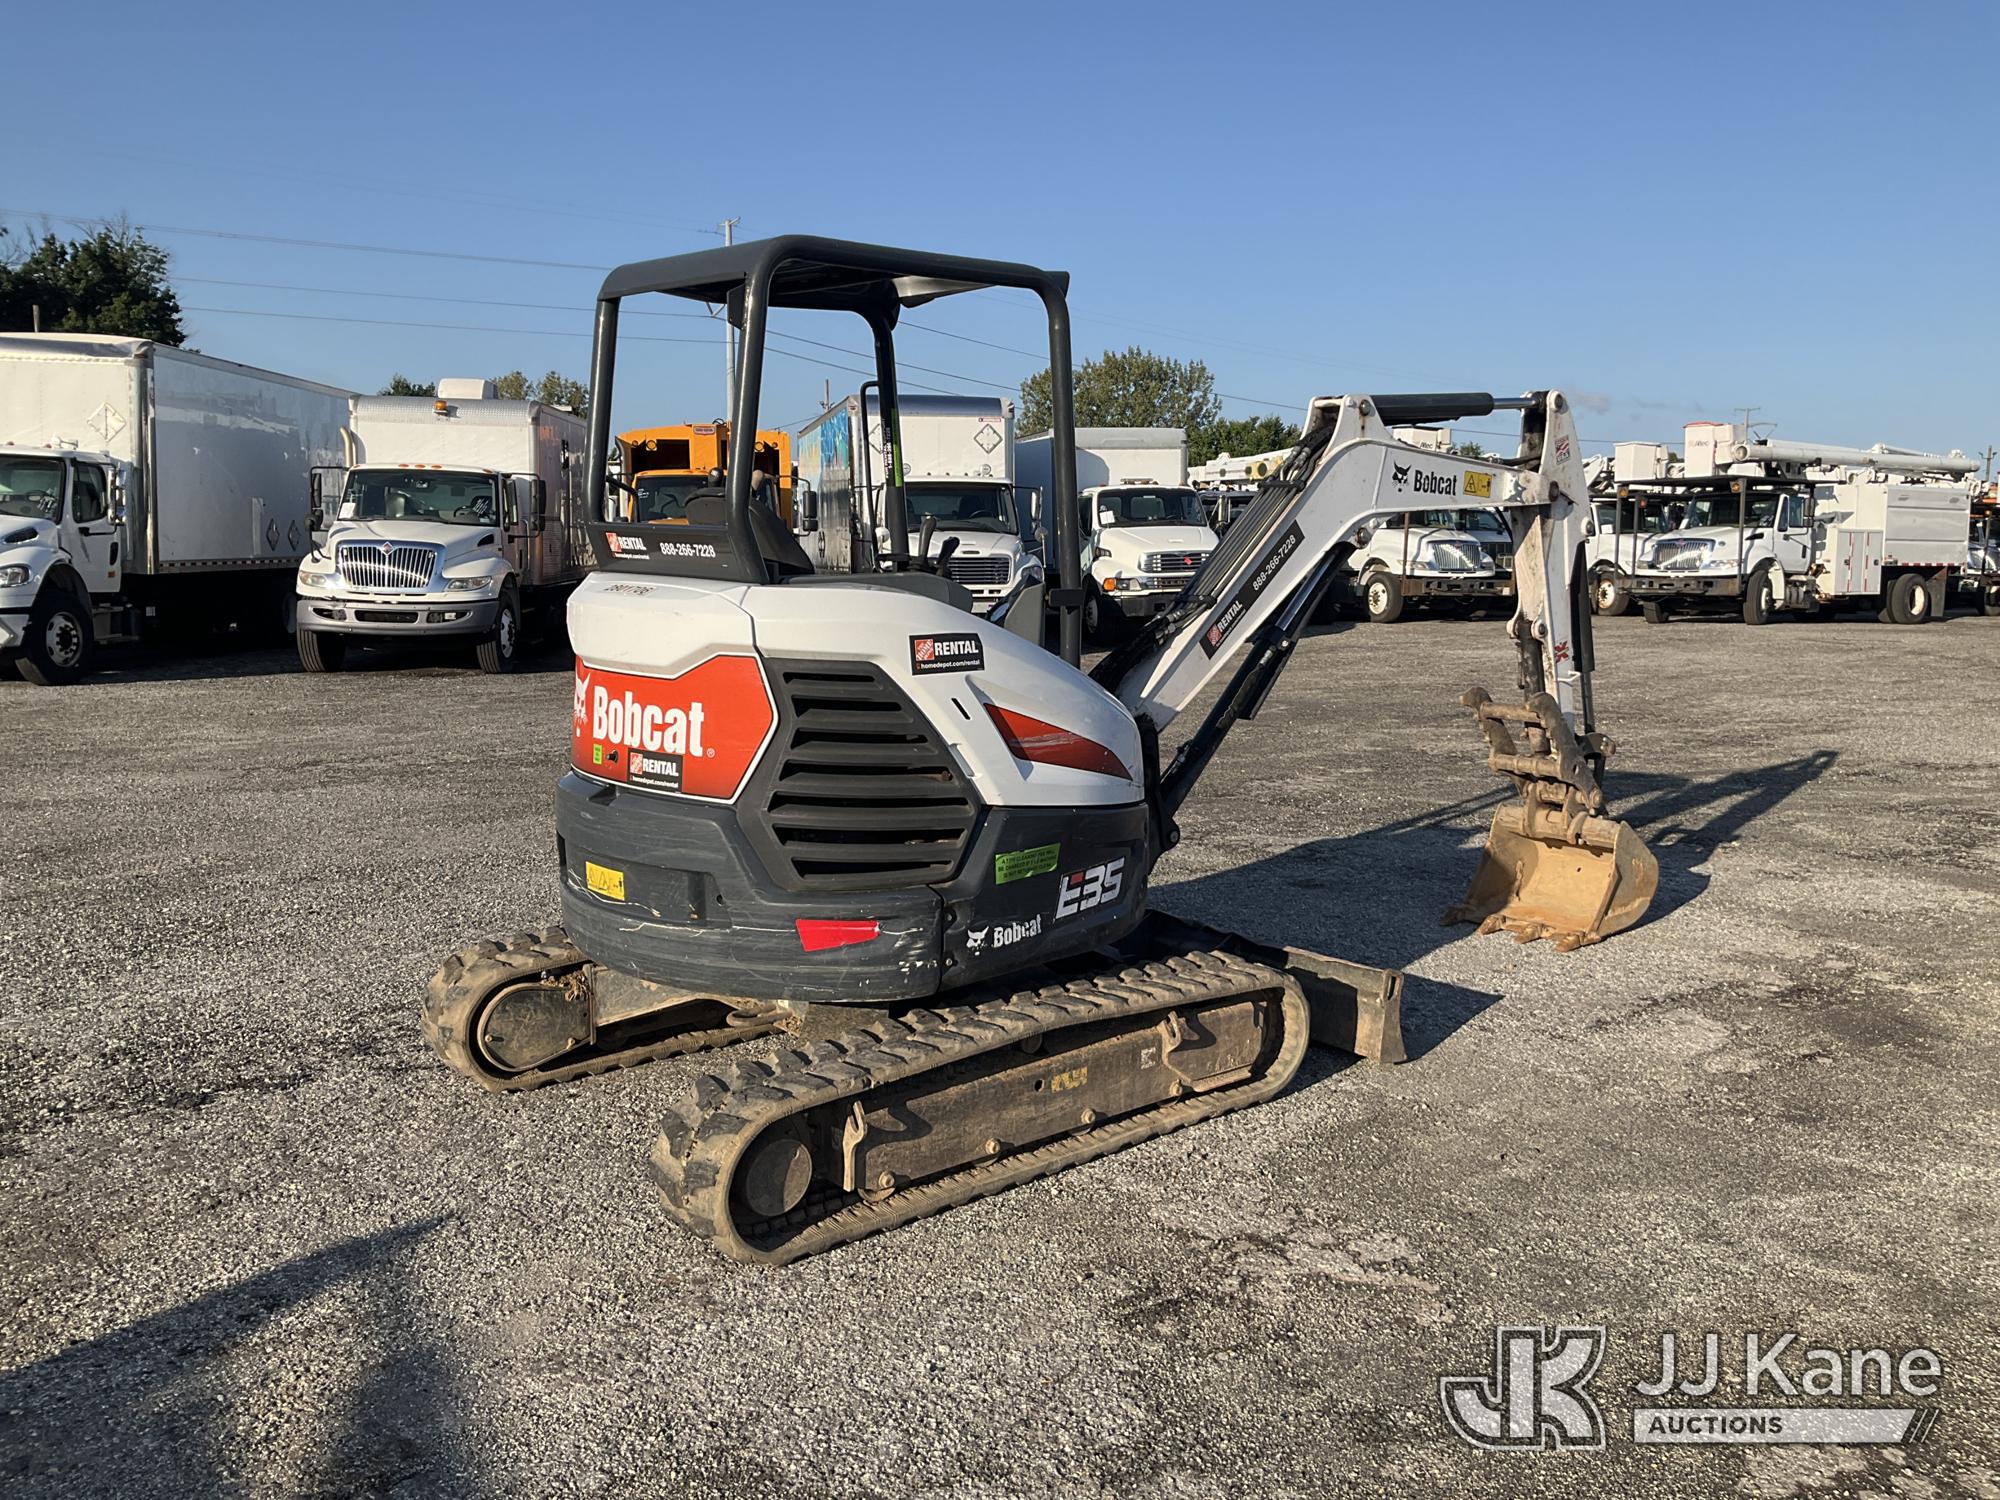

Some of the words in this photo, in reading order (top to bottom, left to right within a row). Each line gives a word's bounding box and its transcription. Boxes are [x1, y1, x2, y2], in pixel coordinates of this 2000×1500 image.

[1413, 470, 1457, 496] Bobcat
[617, 536, 647, 551] RENTAL
[660, 542, 717, 558] 888-266-7228
[1252, 534, 1297, 591] 888-266-7228
[1216, 600, 1243, 633] RENTAL
[934, 640, 979, 656] RENTAL
[920, 660, 980, 669] homedepot.com/rental
[592, 685, 705, 757] Bobcat
[642, 758, 679, 777] RENTAL
[1055, 857, 1125, 919] E35
[993, 913, 1042, 948] Bobcat
